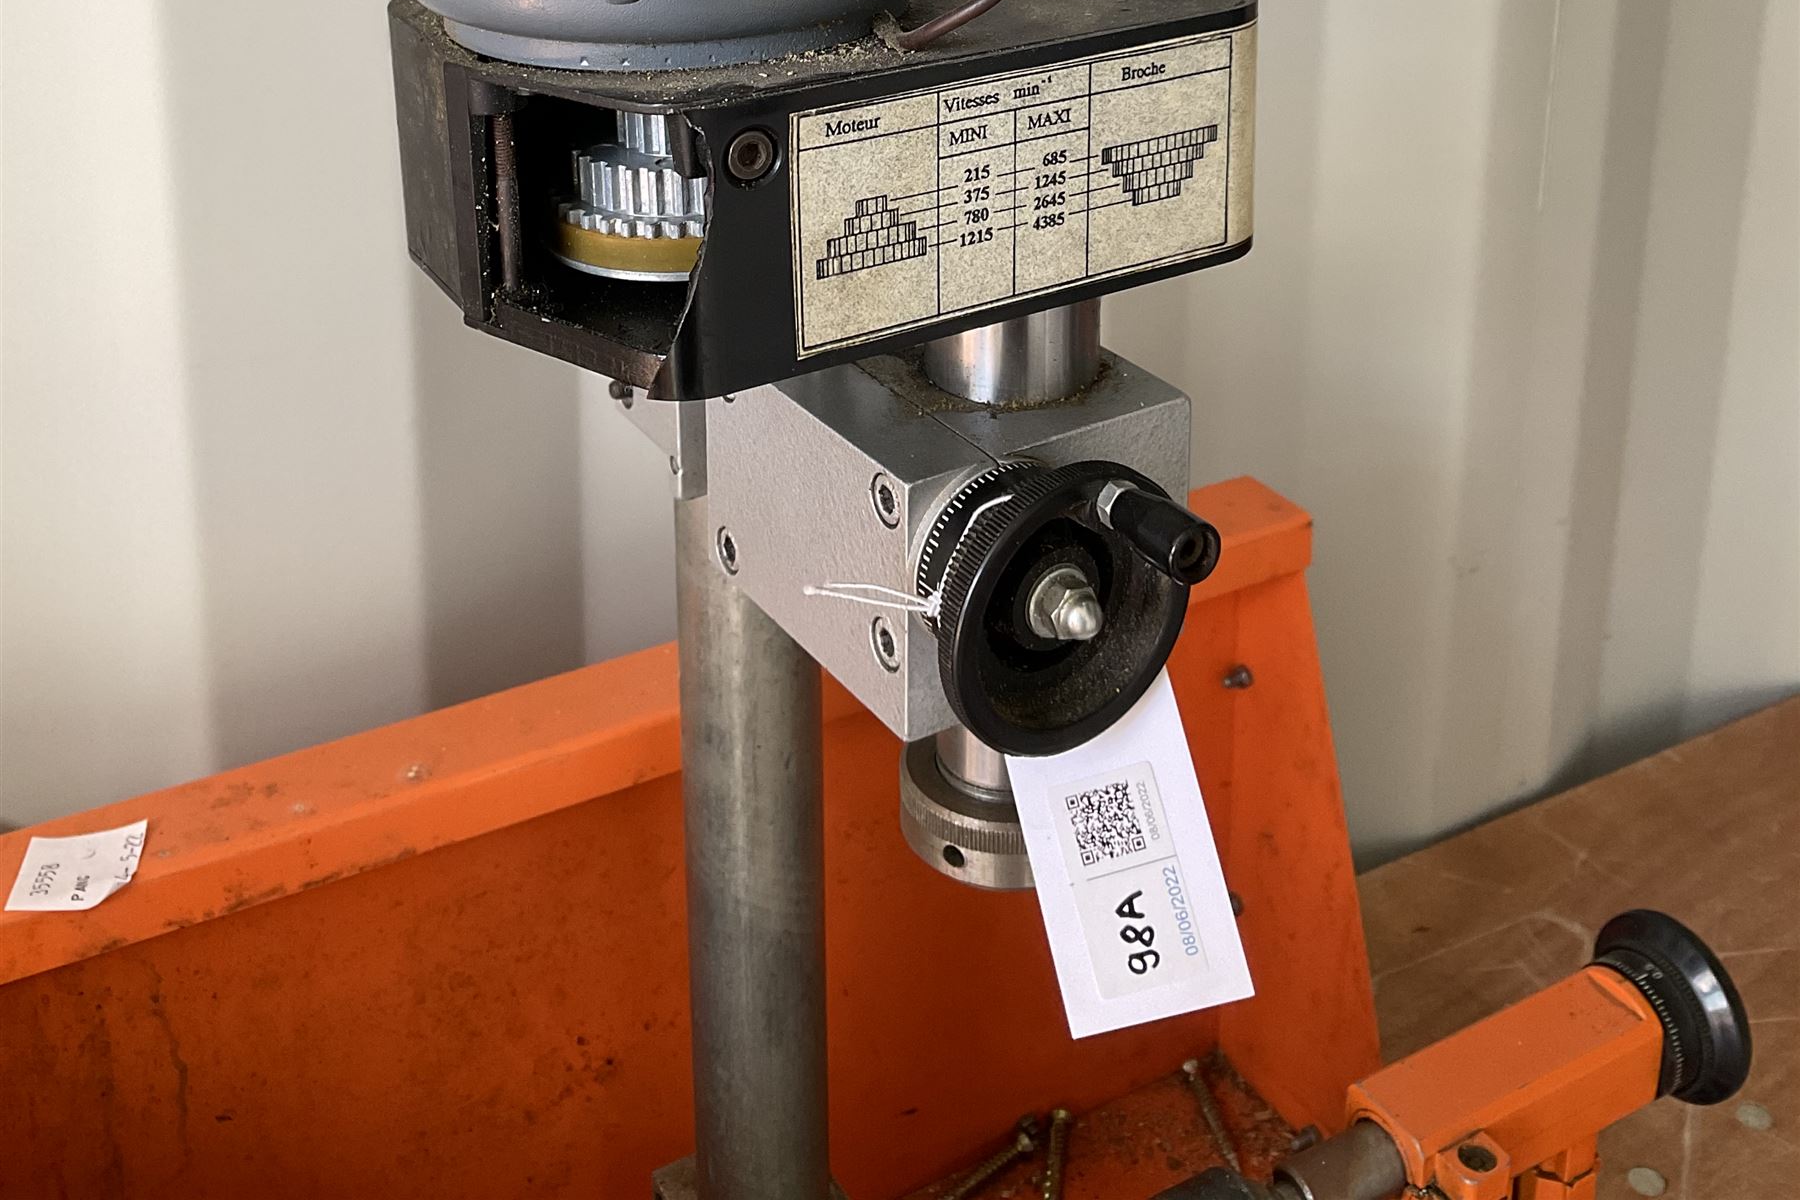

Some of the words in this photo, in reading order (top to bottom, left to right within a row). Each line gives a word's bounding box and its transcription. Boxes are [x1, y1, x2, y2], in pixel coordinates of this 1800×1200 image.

[1121, 62, 1166, 81] Broche
[943, 92, 1000, 113] Vitesses
[825, 117, 881, 137] Moteur
[949, 124, 988, 146] MINI
[1027, 108, 1072, 130] MAXI
[964, 164, 990, 183] 215
[1042, 149, 1067, 167] 685
[963, 186, 990, 204] 375
[1034, 170, 1066, 190] 1245
[964, 207, 989, 225] 780
[1033, 191, 1066, 211] 2645
[959, 226, 993, 247] 1215
[1032, 212, 1065, 231] 4385
[1162, 865, 1199, 956] 08/06/2022
[1115, 890, 1160, 975] 98A
